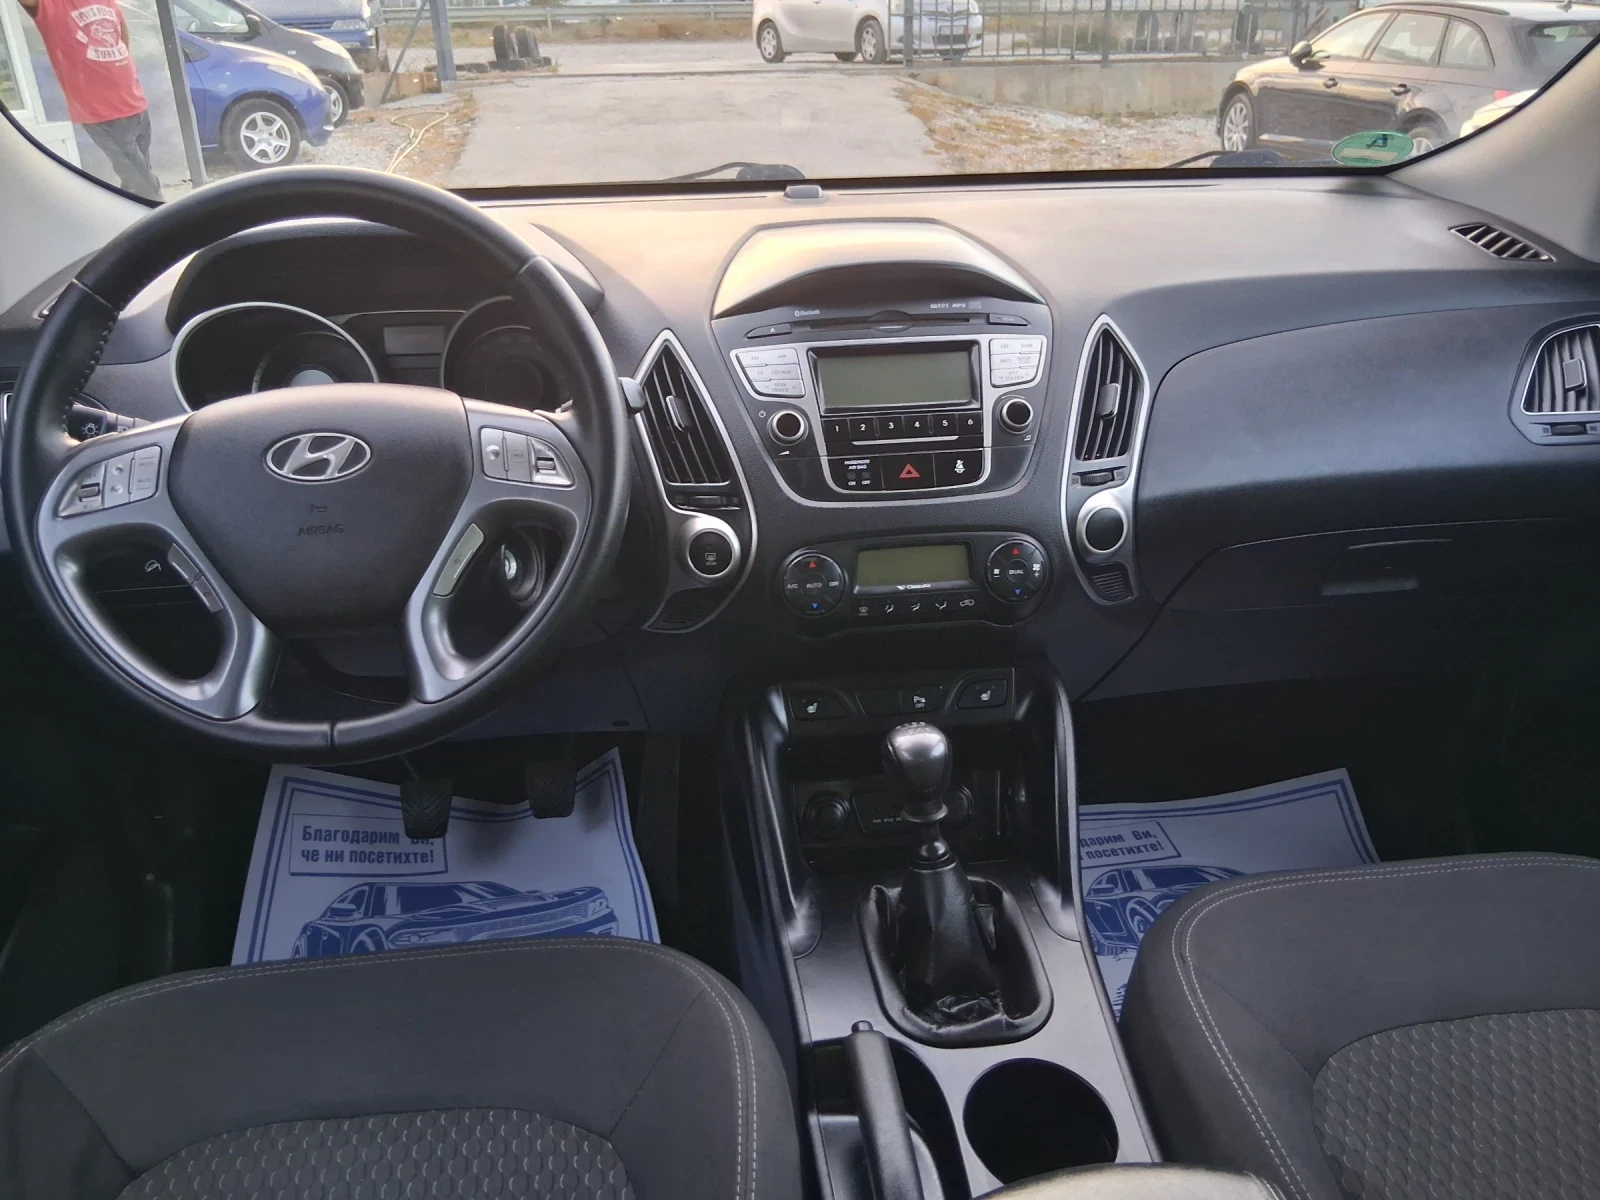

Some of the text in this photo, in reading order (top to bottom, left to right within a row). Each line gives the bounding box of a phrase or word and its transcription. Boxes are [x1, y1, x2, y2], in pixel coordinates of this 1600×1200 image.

[298, 523, 345, 537] AIRBAG
[302, 825, 400, 845] Благодарим
[1131, 830, 1158, 841] Ви,
[301, 849, 435, 864] че ни посетихте!
[1085, 841, 1165, 860] посетихте!
